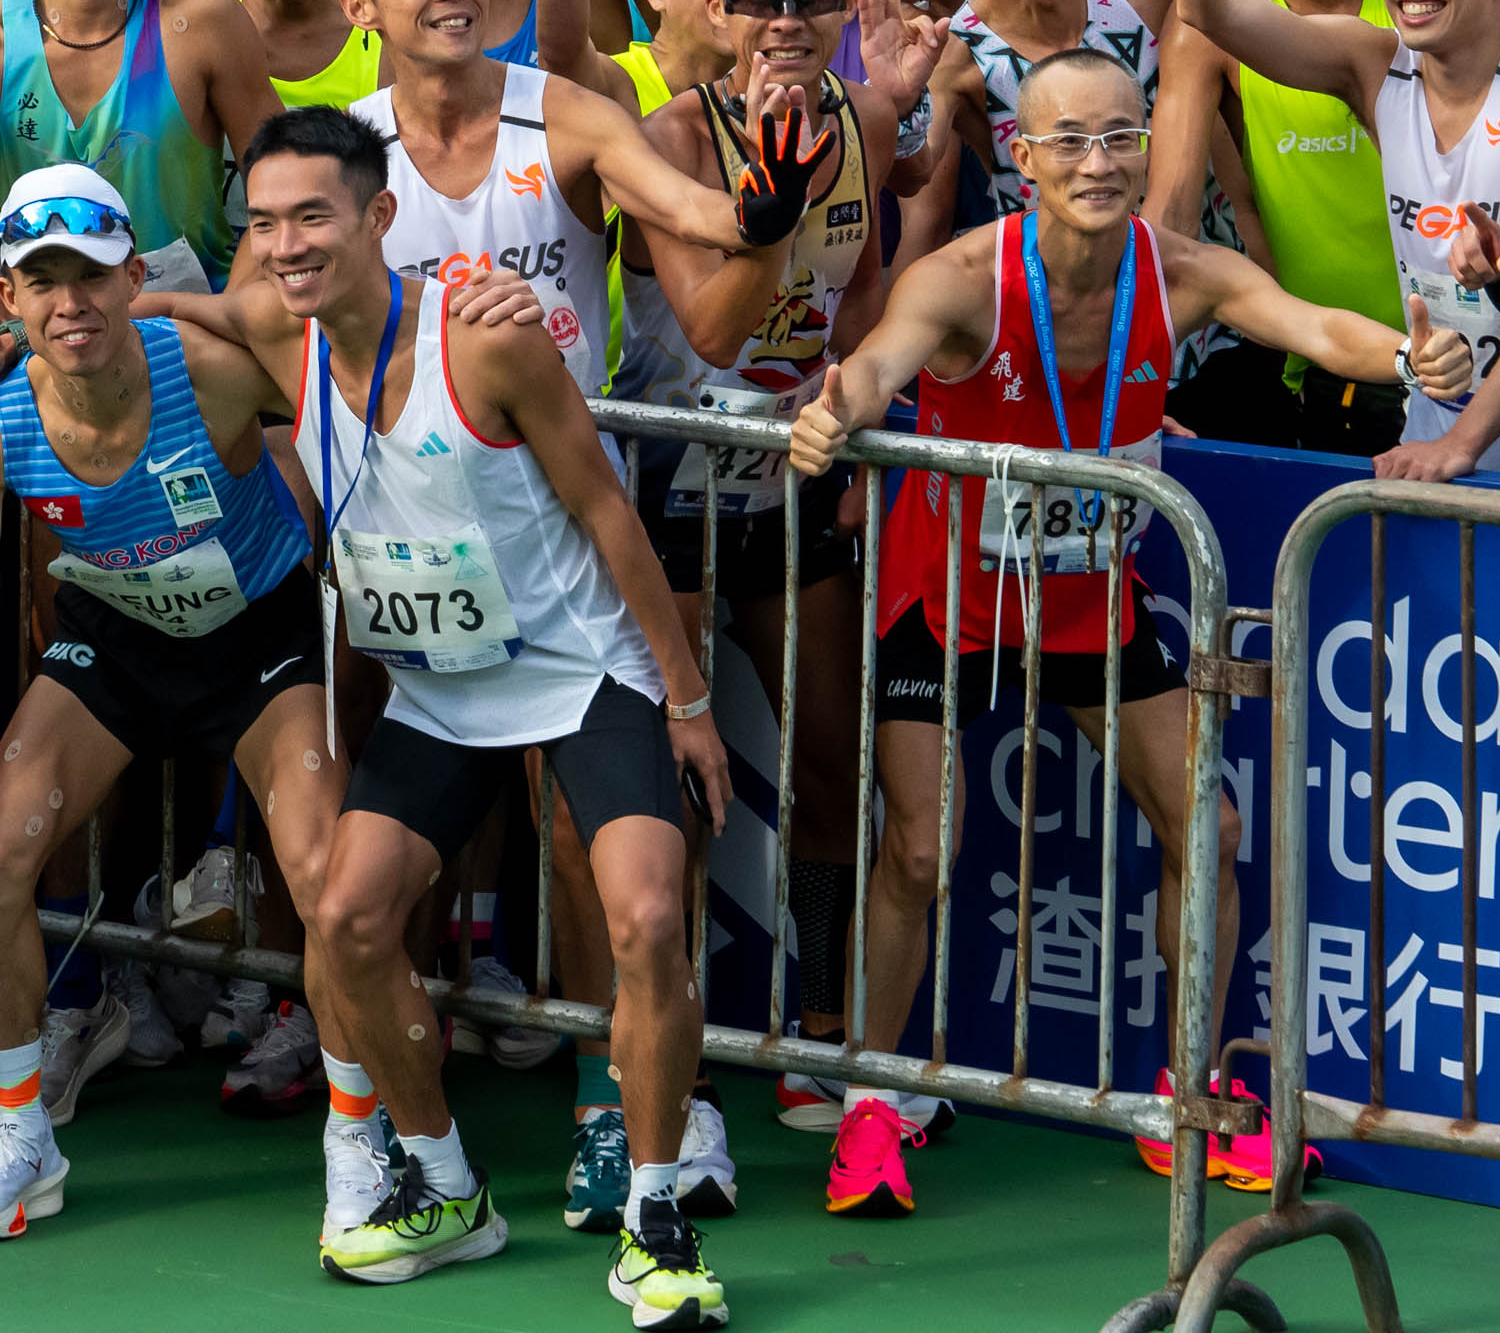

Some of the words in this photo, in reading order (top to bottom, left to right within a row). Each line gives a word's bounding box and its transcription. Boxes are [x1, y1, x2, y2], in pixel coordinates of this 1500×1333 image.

[1297, 133, 1346, 153] asics
[363, 587, 485, 637] 2073
[42, 641, 96, 668] HKG
